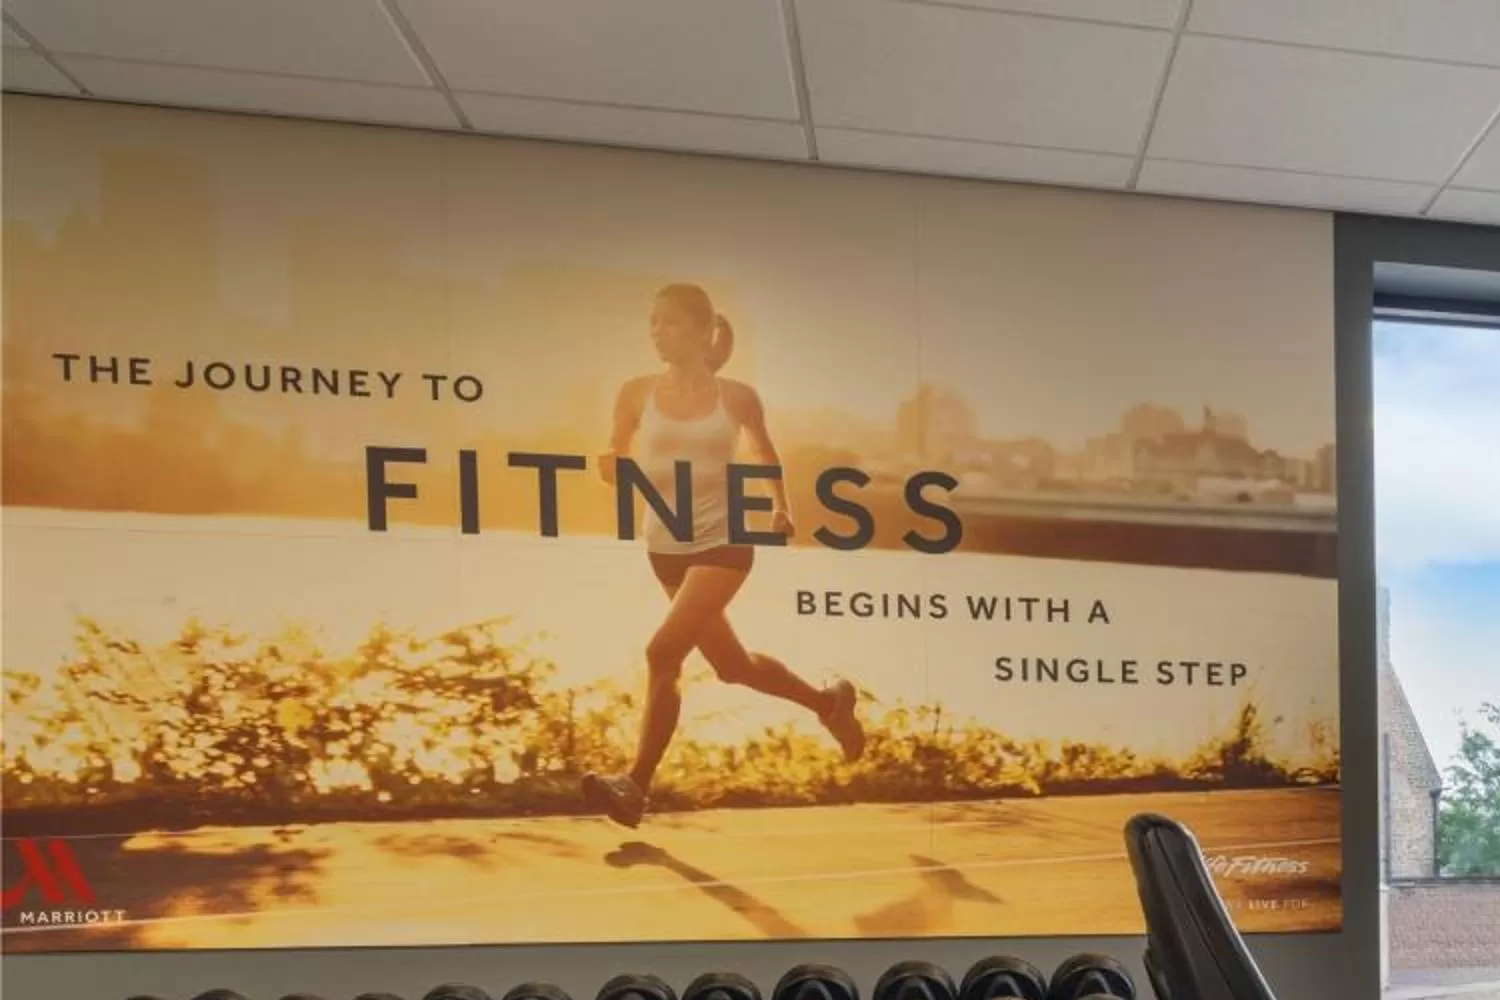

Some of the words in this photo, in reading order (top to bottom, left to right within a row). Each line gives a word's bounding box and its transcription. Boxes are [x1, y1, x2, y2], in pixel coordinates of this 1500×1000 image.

[52, 353, 152, 385] THE
[175, 361, 402, 399] JOURNEY
[422, 374, 484, 402] TO
[365, 445, 964, 554] FITNESS
[796, 591, 949, 620] BEGINS
[966, 595, 1070, 623] WITH
[1087, 600, 1111, 624] A
[994, 657, 1139, 684] SINGLE
[1156, 661, 1248, 687] STEP
[20, 908, 128, 924] MARRIOTT
